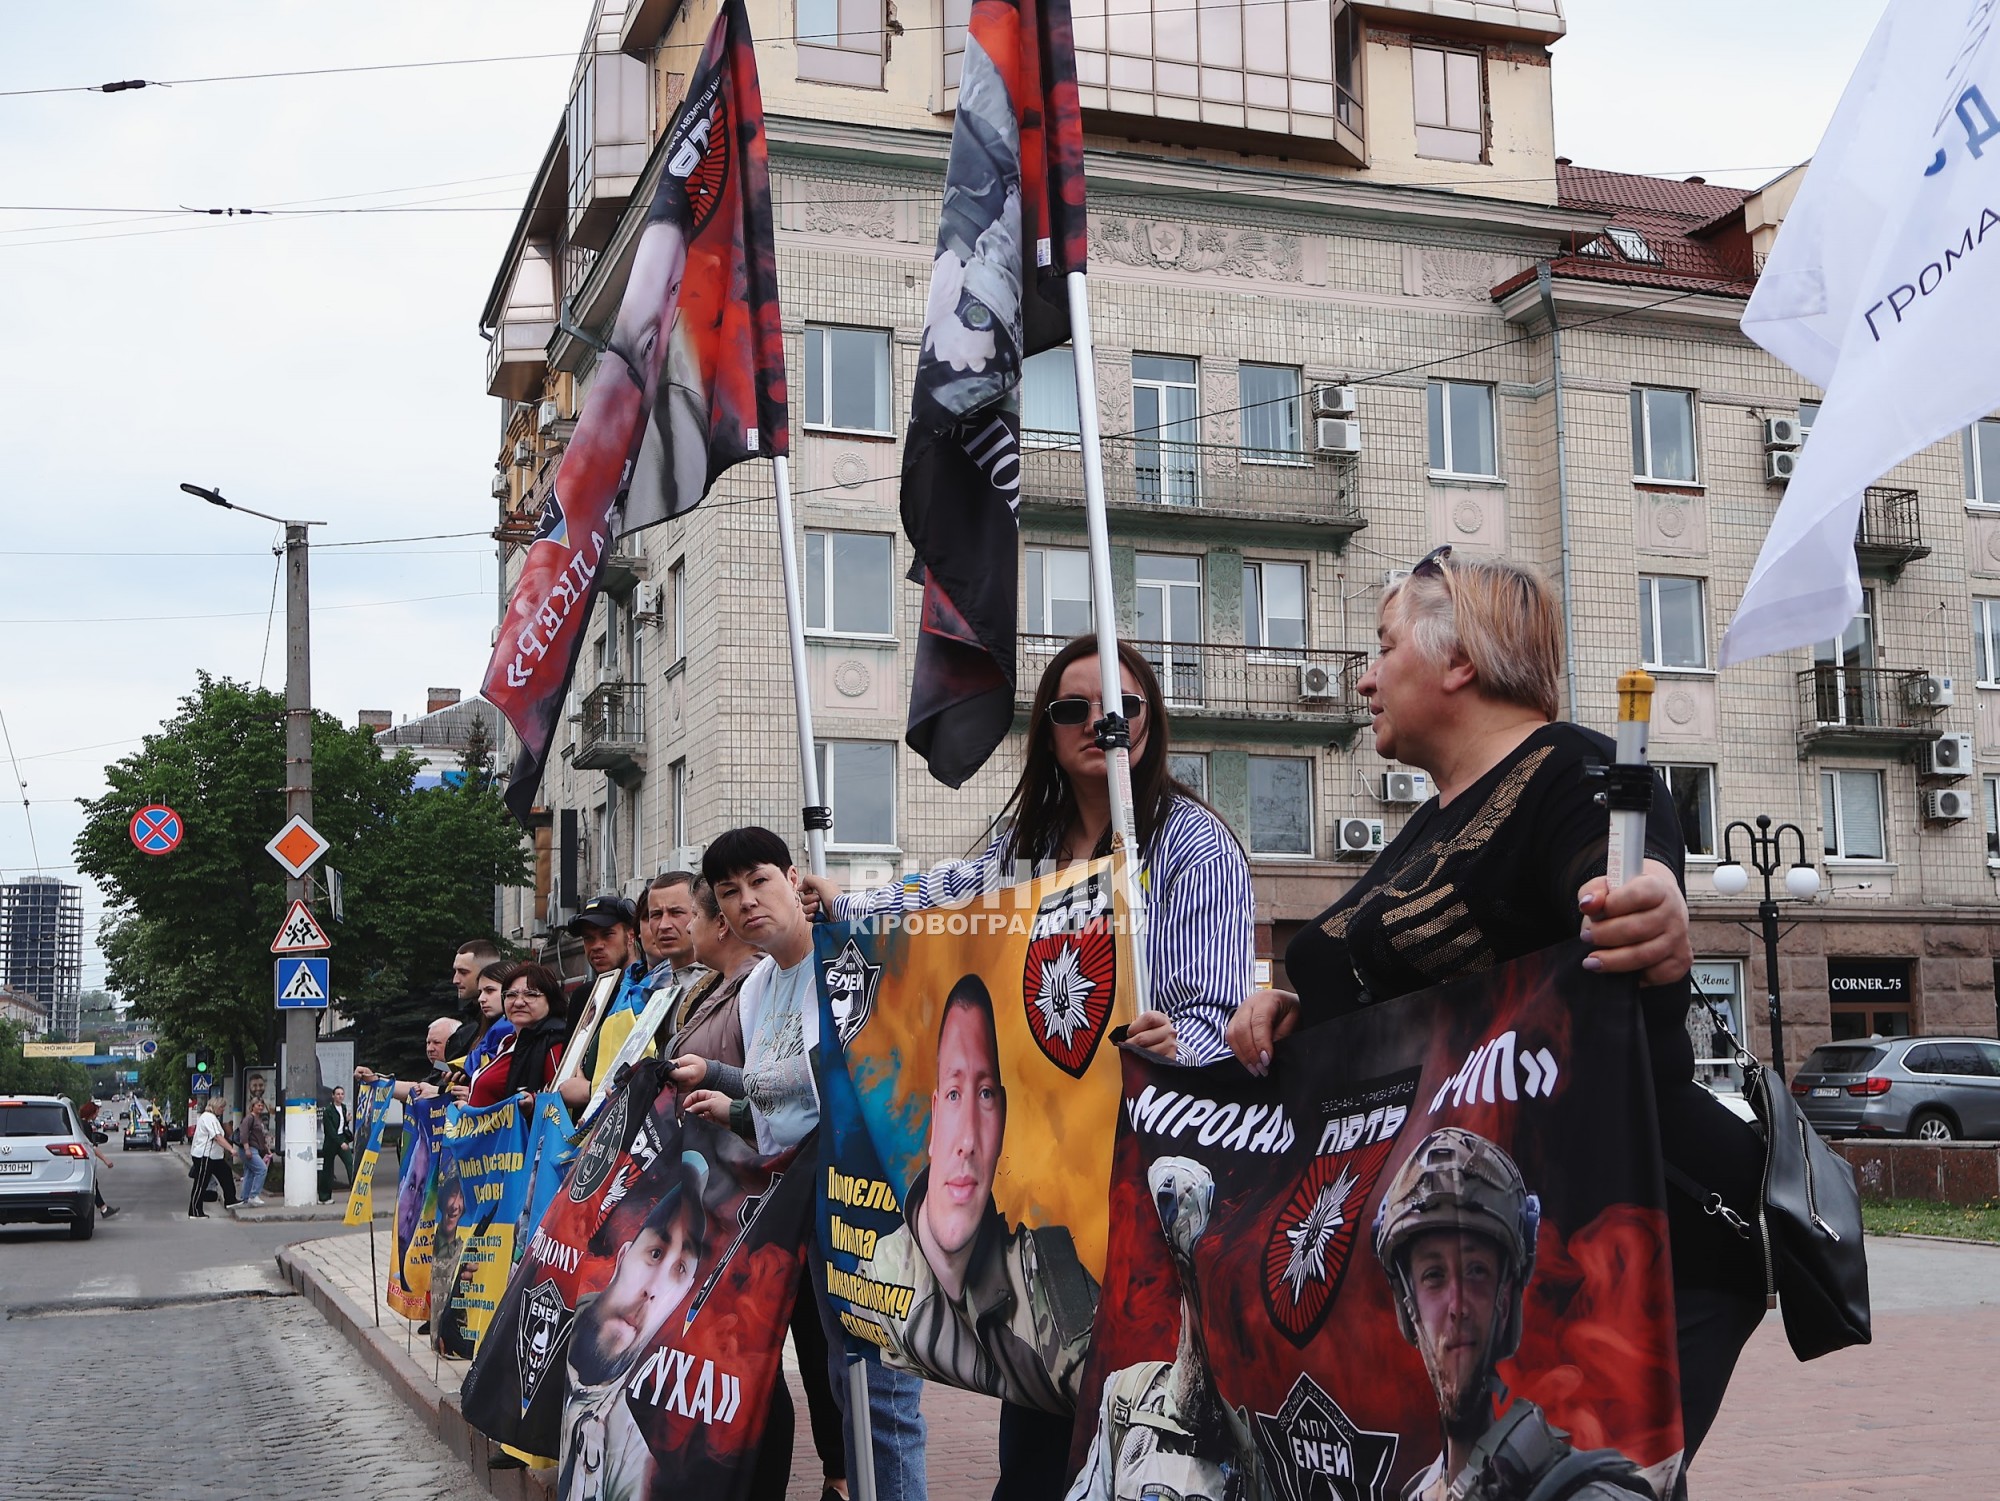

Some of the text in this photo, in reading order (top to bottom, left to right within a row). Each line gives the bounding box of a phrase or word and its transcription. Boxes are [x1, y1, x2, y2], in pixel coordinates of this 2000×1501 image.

[1700, 973, 1730, 985] Home
[1831, 977, 1902, 990] CORNER_75
[1126, 1084, 1296, 1154] «МІРОХА»
